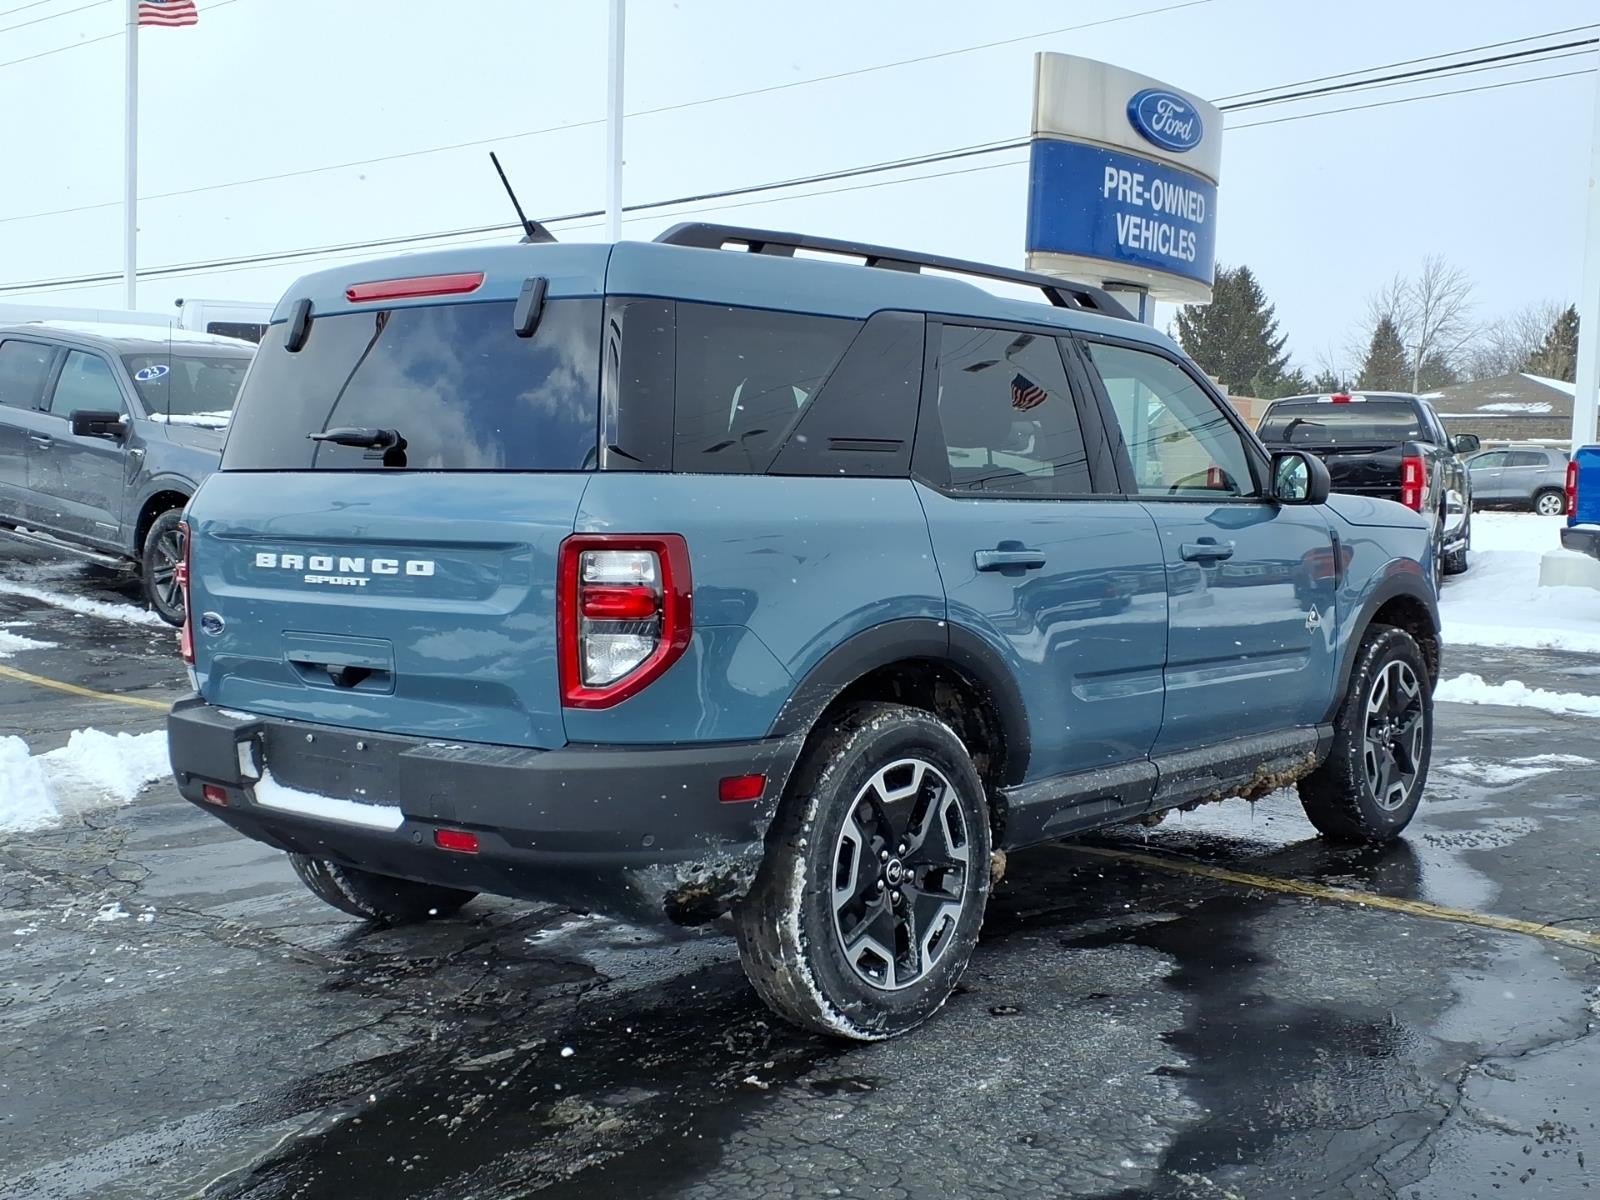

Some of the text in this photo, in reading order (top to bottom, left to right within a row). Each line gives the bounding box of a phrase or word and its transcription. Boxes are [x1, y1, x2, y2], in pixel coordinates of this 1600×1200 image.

[1152, 99, 1193, 141] Ford
[1103, 166, 1206, 224] PRE-OWNED
[1116, 212, 1196, 263] VEHICLES
[255, 552, 435, 576] BRONCO
[304, 574, 370, 586] SPORT
